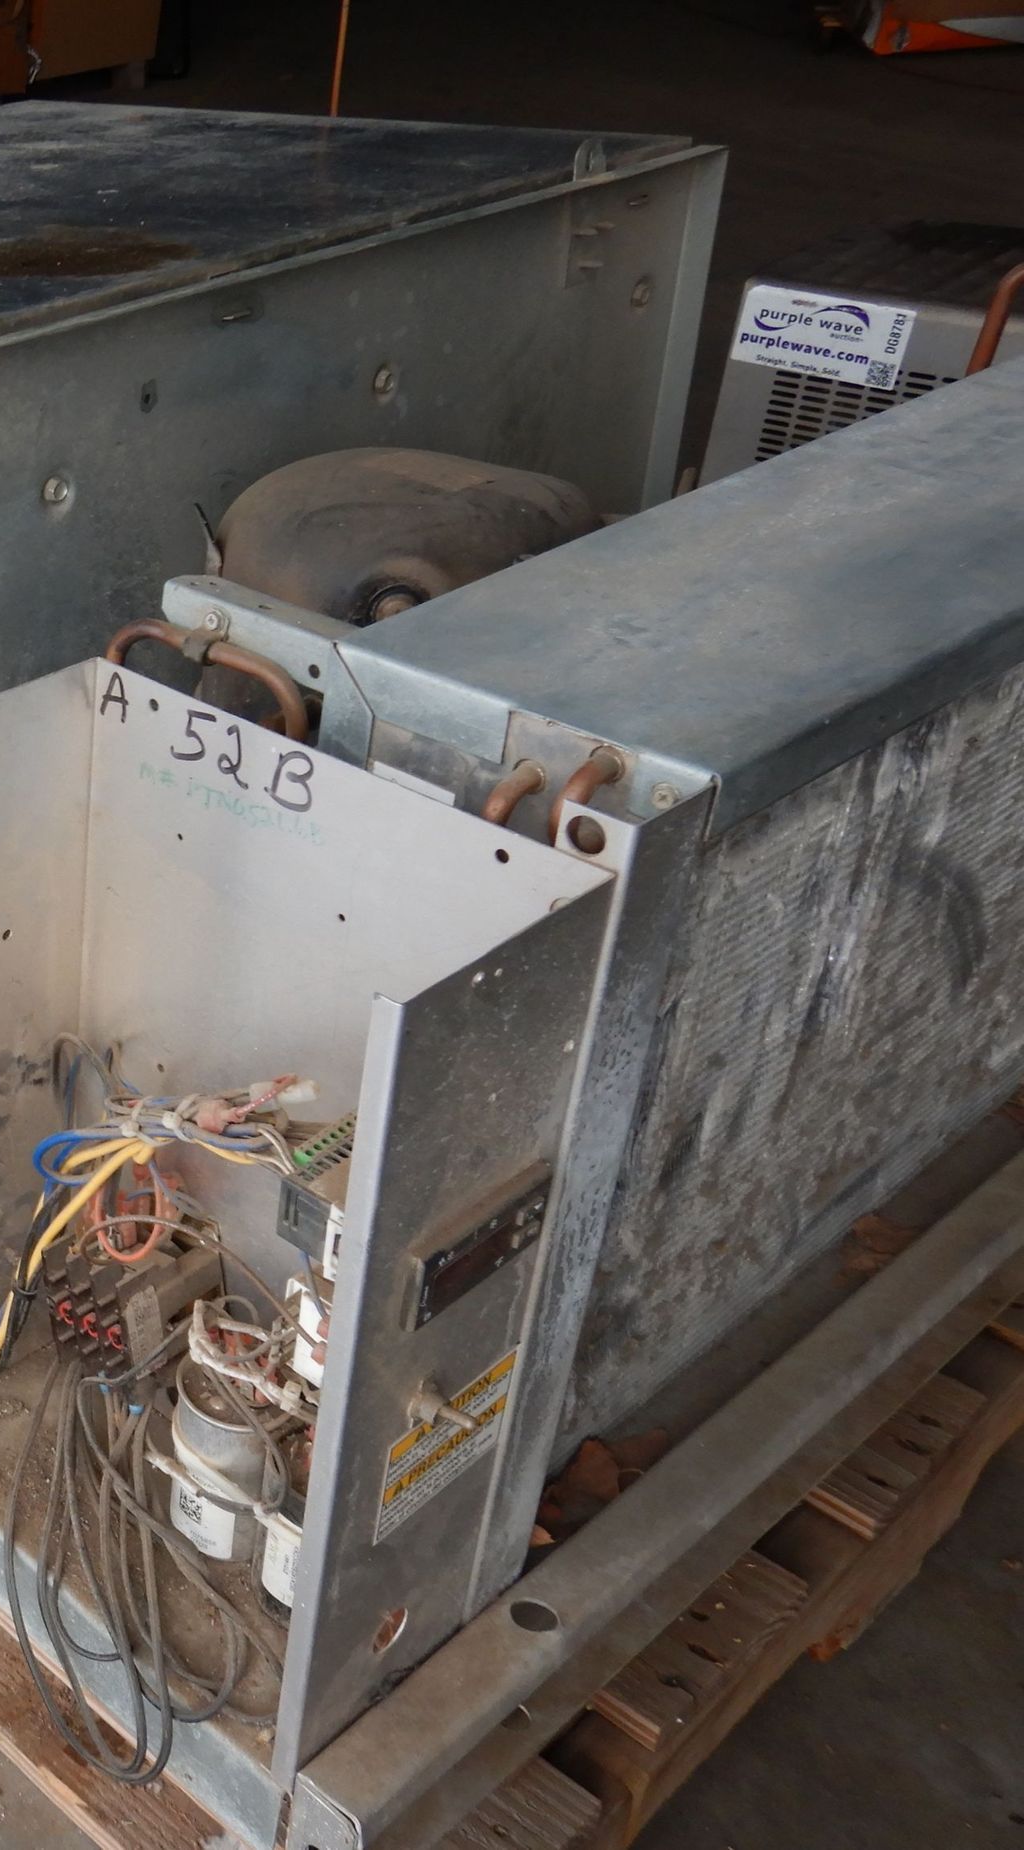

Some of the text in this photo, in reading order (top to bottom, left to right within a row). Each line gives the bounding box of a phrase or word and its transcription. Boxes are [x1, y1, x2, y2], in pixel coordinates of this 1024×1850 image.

[760, 308, 864, 335] purple wave
[884, 313, 907, 355] DG8781
[740, 332, 869, 365] purplewave.com
